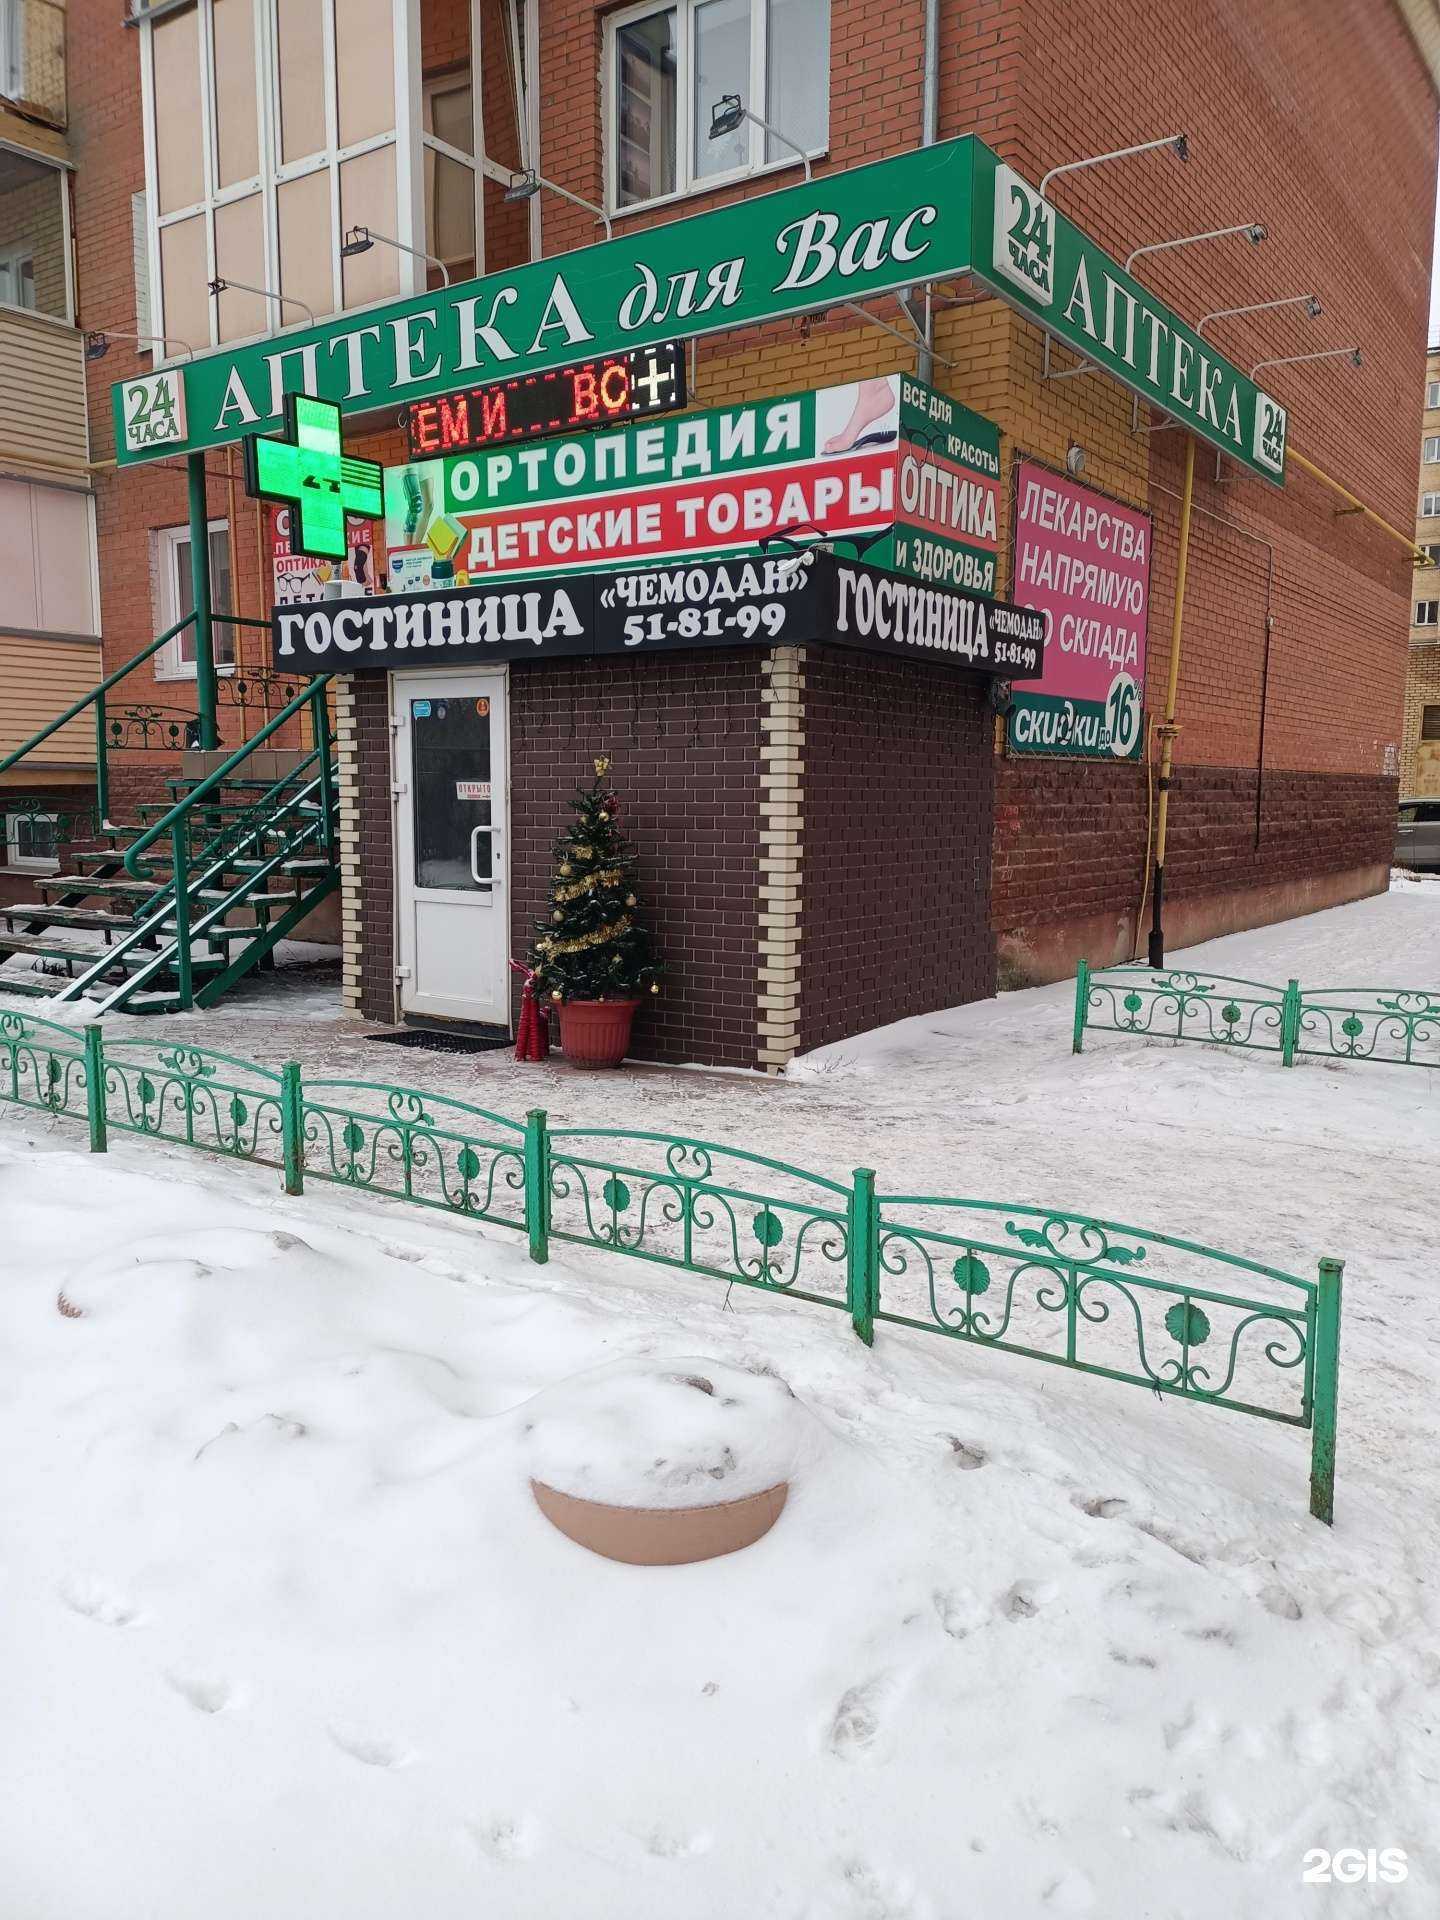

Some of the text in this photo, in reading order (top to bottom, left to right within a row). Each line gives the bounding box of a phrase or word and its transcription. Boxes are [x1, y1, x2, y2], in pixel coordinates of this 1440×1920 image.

[1008, 184, 1052, 266] 24
[1008, 239, 1051, 294] ЧАСА
[213, 205, 937, 431] АПТЕКА для Вас
[1062, 253, 1244, 447] АПТЕКА
[127, 376, 175, 427] 24
[903, 380, 953, 425] ВСЕ ДЛЯ
[1263, 403, 1284, 450] 24
[127, 419, 180, 445] ЧАСА
[450, 400, 801, 502] ОРТОПЕДИЯ
[948, 433, 999, 475] КРАСОТЫ
[1262, 438, 1282, 467] ЧАСА
[468, 467, 895, 571] ДЕТСКИЕ ТОВАРЫ
[900, 454, 998, 542] ОПТИКА
[1020, 480, 1146, 565] ЛЕКАРСТВА
[600, 559, 809, 609] «ЧЕМОДАН»
[912, 537, 995, 593] ЗДОРОВЬЯ
[1020, 542, 1144, 616] НАПРЯМУЮ
[278, 588, 585, 656] ГОСТИНИЦА
[623, 602, 787, 647] 51-81-99
[836, 568, 990, 662] ГОСТИНИЦА
[989, 608, 1044, 641] «ЧЕМОДАН»
[1060, 614, 1138, 671] СКЛАДА
[994, 641, 1036, 670] 51-81-99
